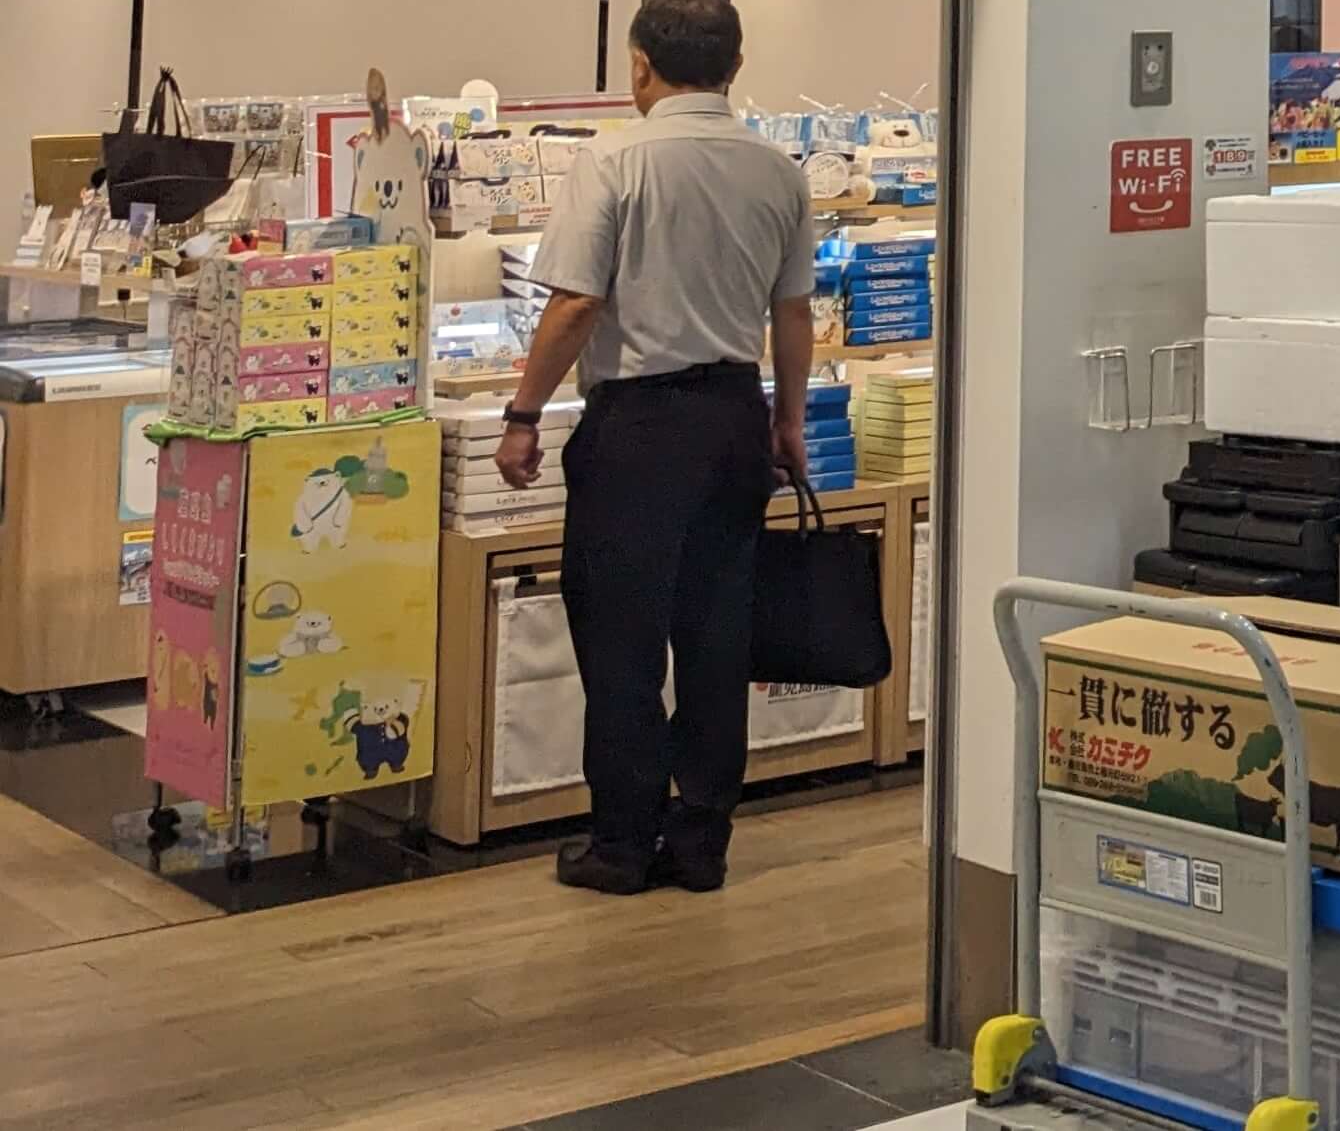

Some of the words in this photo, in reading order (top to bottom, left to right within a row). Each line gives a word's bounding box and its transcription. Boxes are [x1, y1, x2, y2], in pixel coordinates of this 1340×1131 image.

[1121, 147, 1182, 168] FREE
[1214, 150, 1247, 163] 189
[1119, 172, 1182, 195] Wi-Fi
[1049, 674, 1236, 750] 一貫に徹する
[1087, 735, 1152, 771] カミチク
